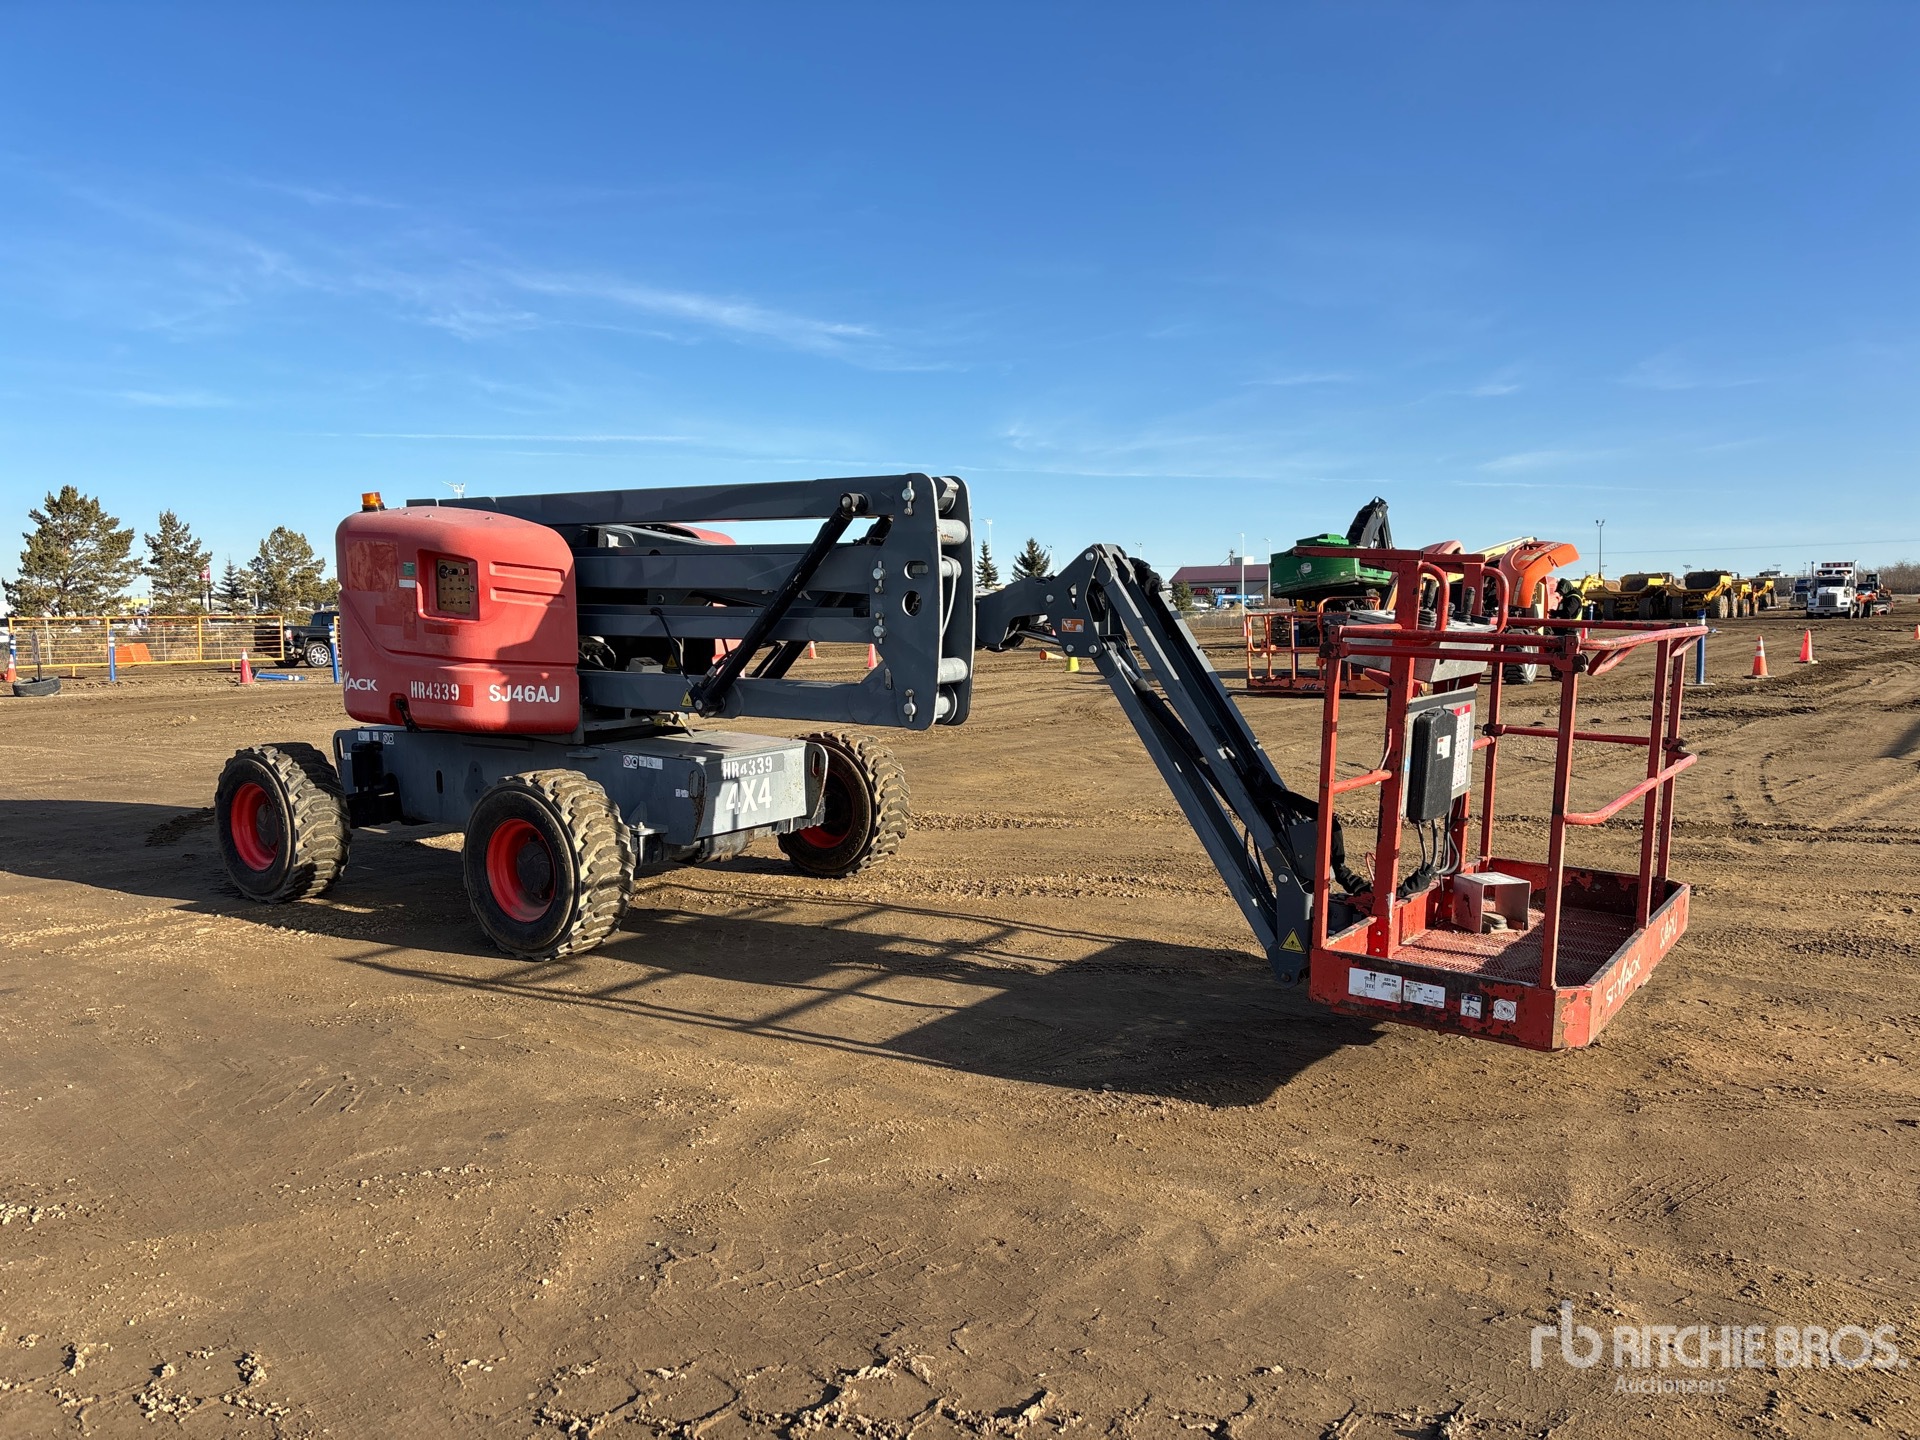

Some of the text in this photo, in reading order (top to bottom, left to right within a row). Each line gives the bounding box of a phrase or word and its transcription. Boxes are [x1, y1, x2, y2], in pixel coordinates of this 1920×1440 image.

[410, 680, 460, 701] HR4339
[489, 684, 561, 704] SJ46AJ
[722, 756, 773, 780] HR4339
[725, 777, 773, 815] 4X4
